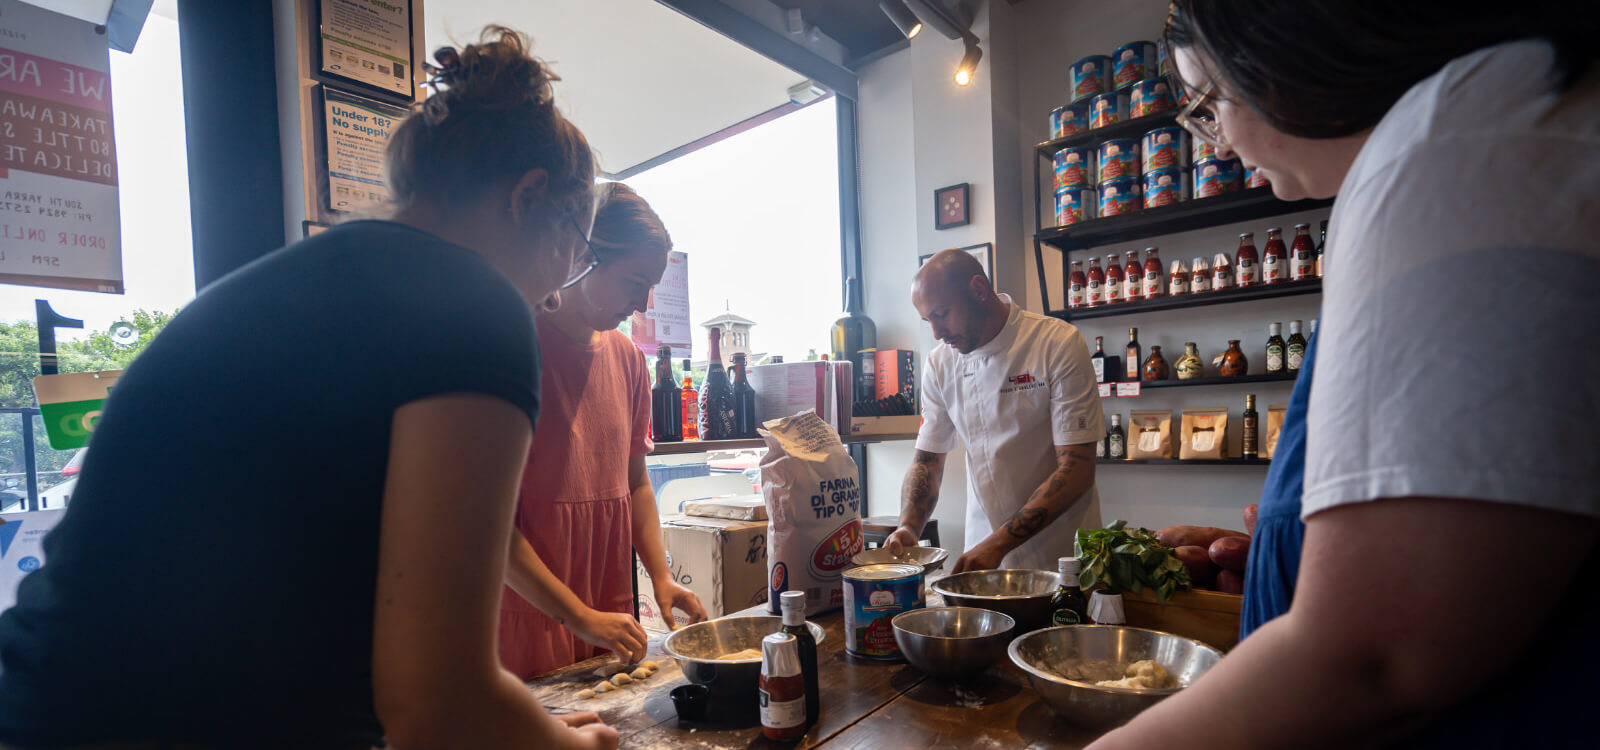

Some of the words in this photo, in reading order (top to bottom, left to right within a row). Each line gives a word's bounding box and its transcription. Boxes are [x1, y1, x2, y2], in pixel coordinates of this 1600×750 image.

[332, 105, 369, 123] Under
[371, 116, 392, 129] 18?
[332, 116, 350, 129] No
[352, 123, 391, 141] supply
[820, 476, 856, 493] FARINA
[811, 494, 826, 508] DI
[813, 503, 845, 519] TIPO
